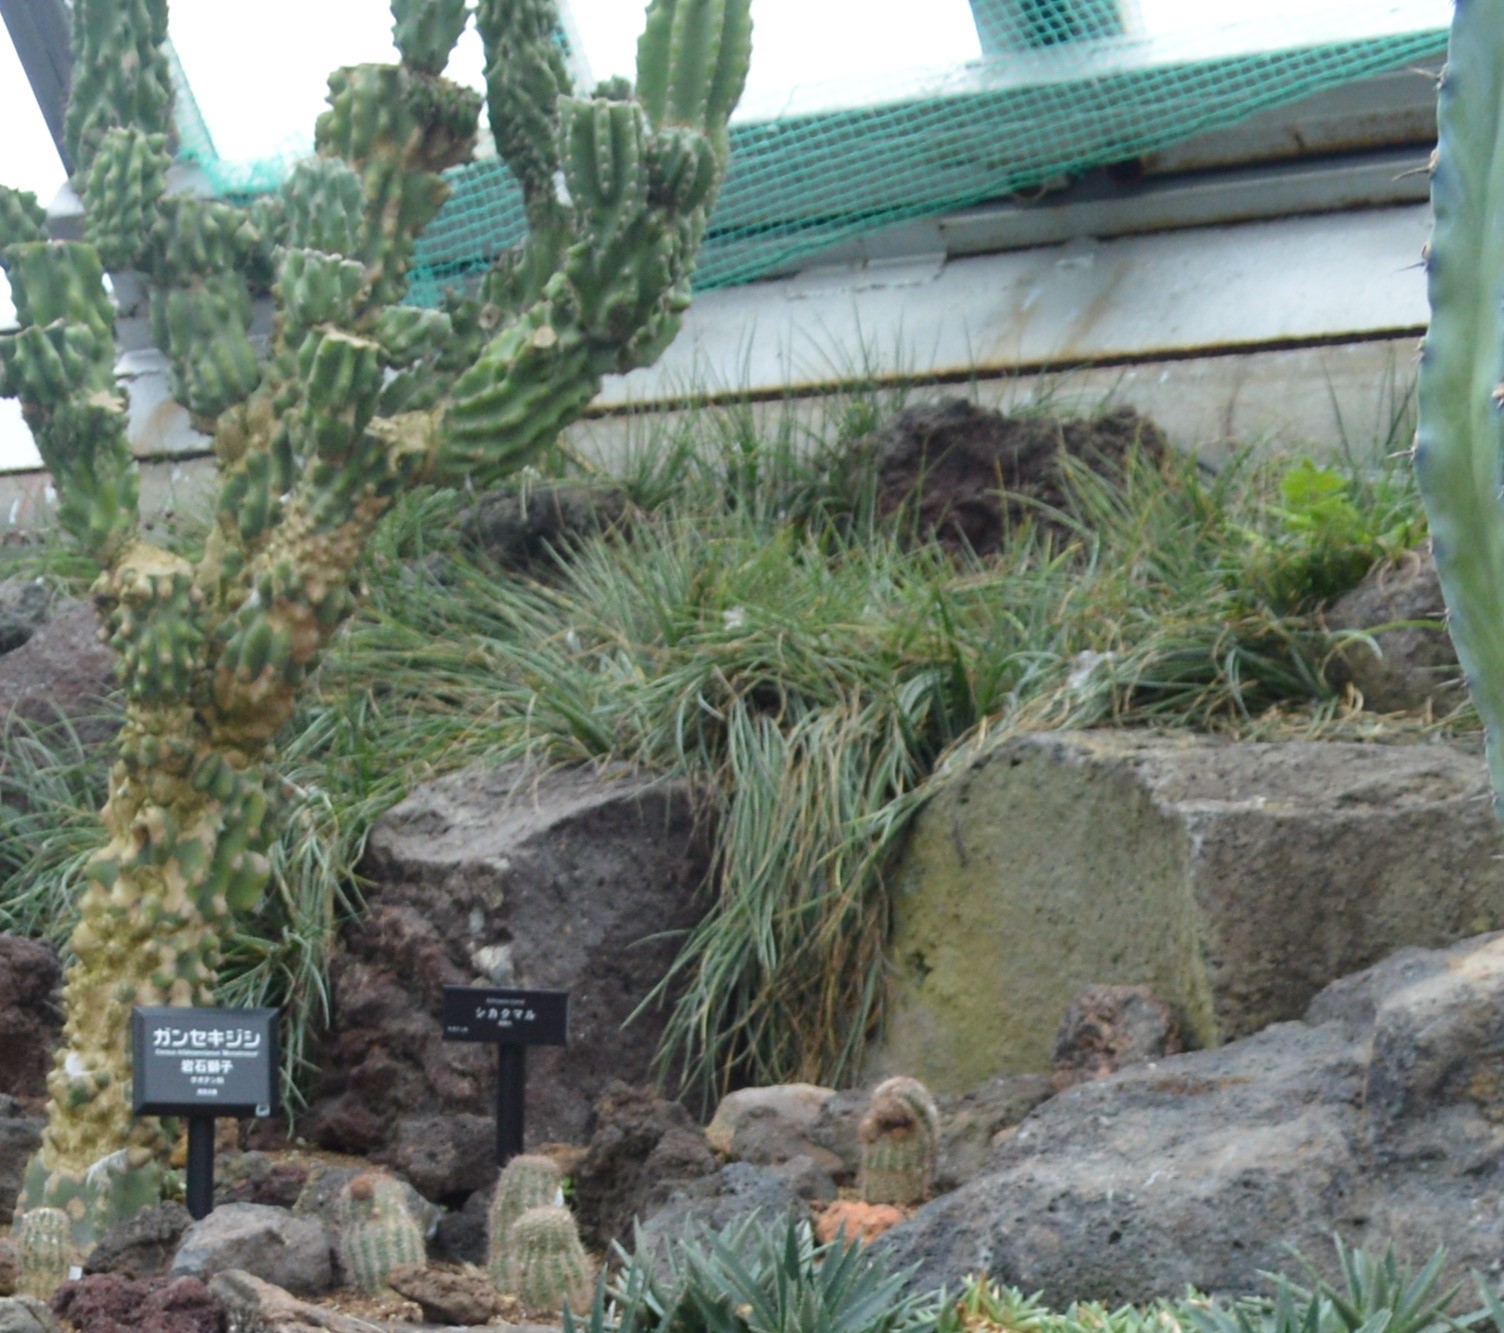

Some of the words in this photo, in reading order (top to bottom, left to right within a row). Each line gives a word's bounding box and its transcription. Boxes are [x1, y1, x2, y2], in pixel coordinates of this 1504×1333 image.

[475, 1006, 537, 1021] シカクマル
[153, 1027, 261, 1048] ガンセキジシ
